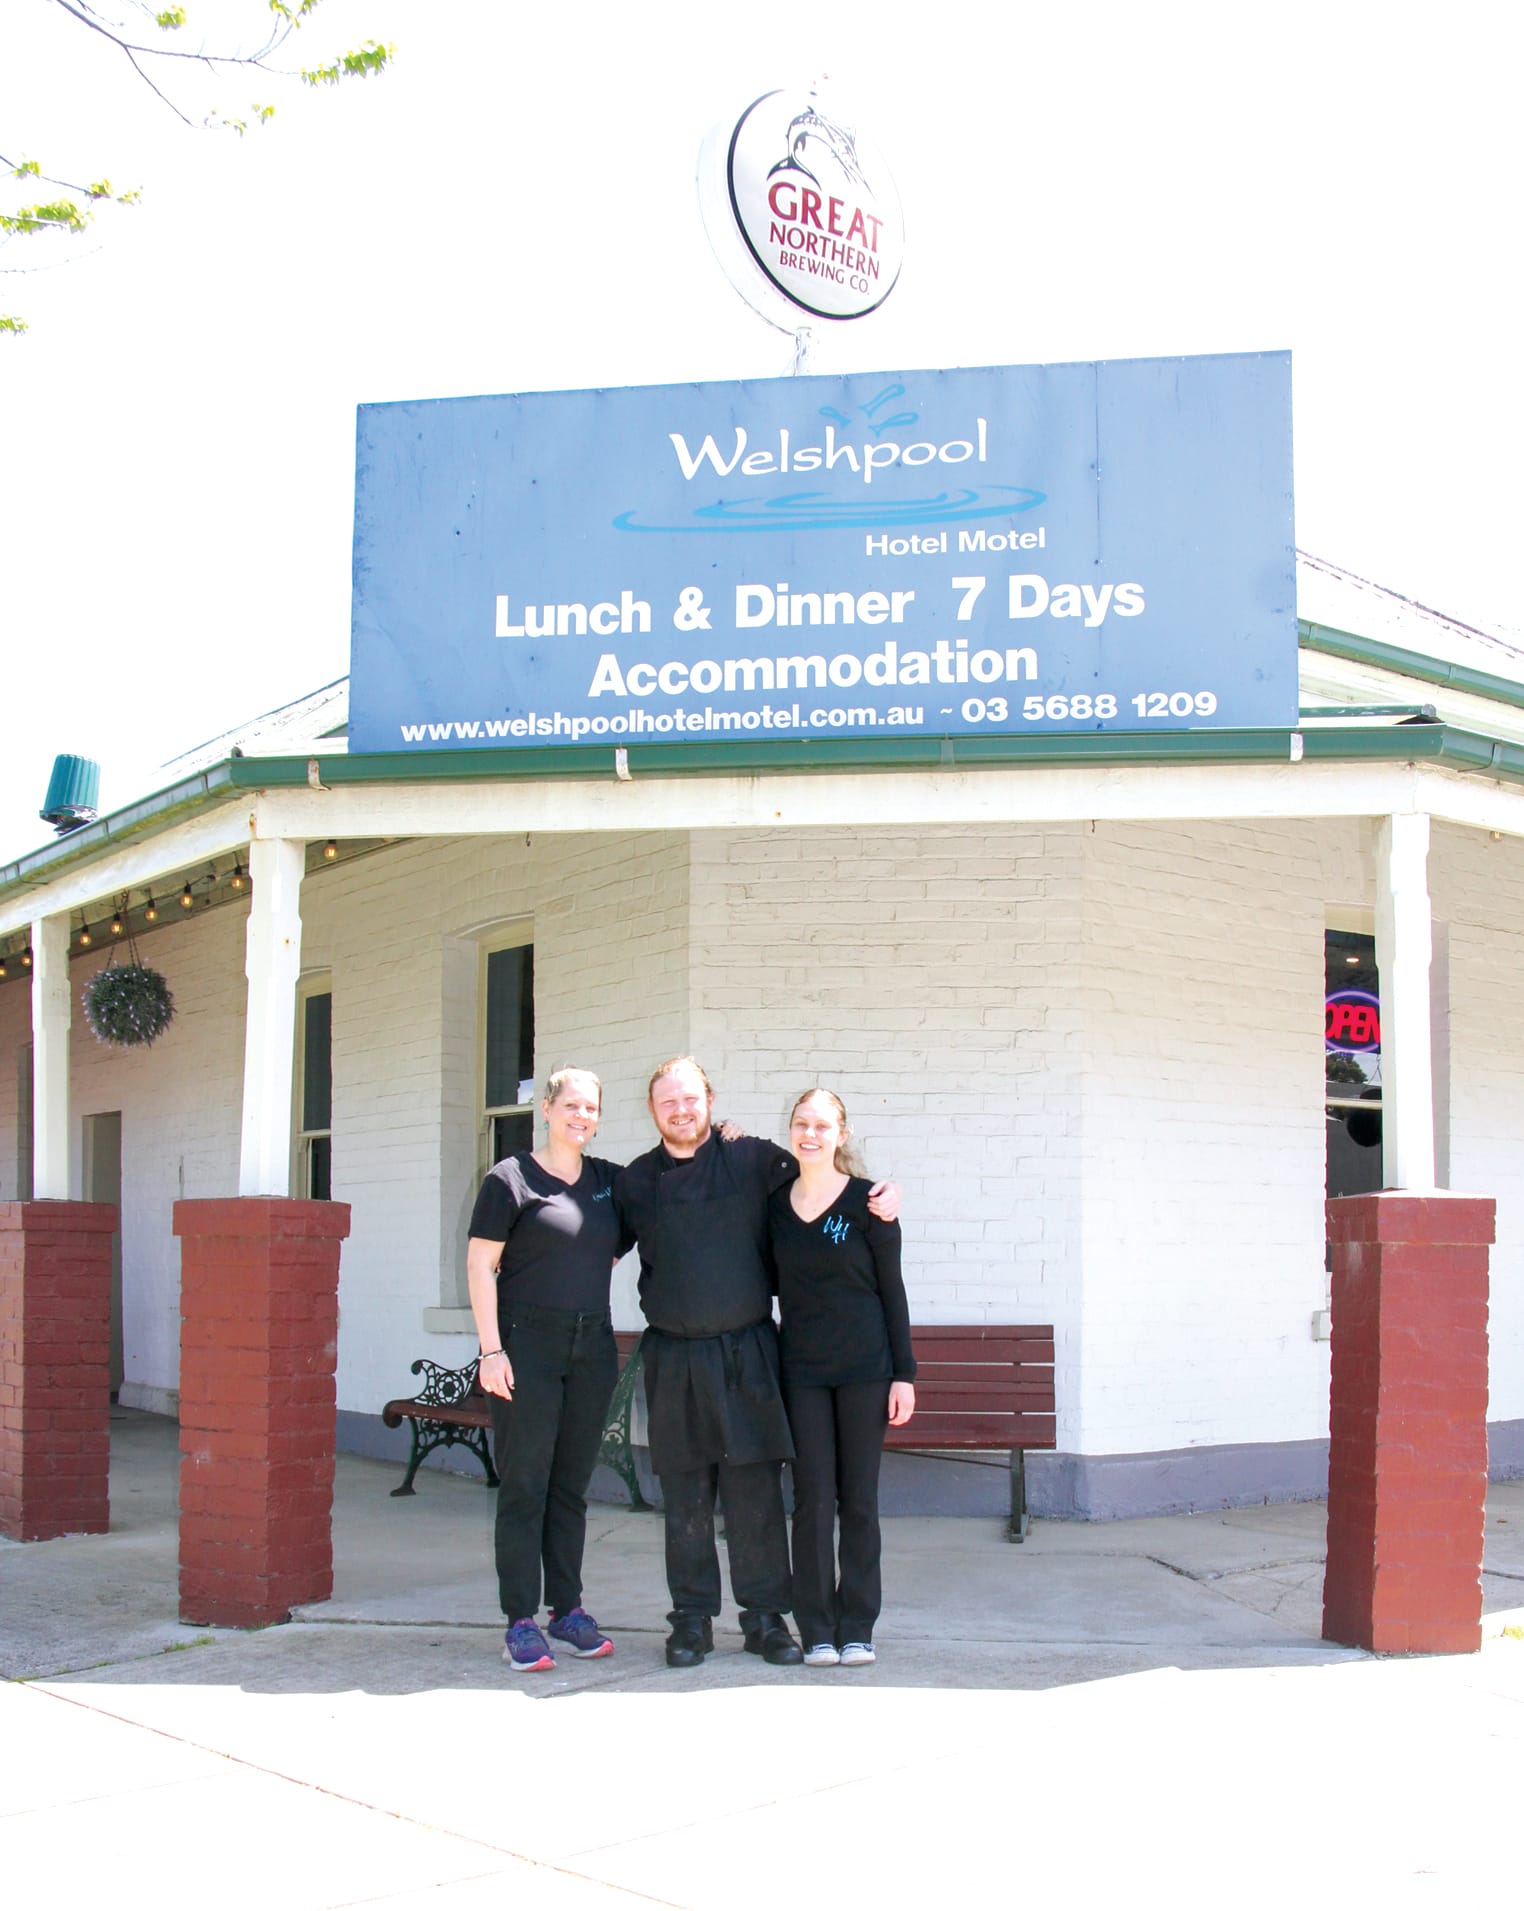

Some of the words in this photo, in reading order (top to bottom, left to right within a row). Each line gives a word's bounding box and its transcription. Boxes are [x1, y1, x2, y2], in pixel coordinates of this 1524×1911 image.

[767, 181, 883, 254] GREAT
[769, 221, 880, 281] NORTHERN
[779, 251, 845, 285] BREWING
[849, 274, 869, 296] CO.
[669, 417, 987, 484] Welshpool
[865, 532, 948, 556] Hotel
[958, 527, 1046, 553] Motel
[495, 590, 652, 638] Lunch
[673, 586, 713, 632] &
[735, 583, 915, 628] Dinner
[951, 576, 986, 621] 7
[1008, 574, 1146, 628] Days
[588, 639, 1039, 697] Accommodation
[400, 703, 924, 742] www.welshpoolhotelmotel.com.au
[961, 697, 1009, 723] 03
[1022, 694, 1118, 721] 5688
[1131, 691, 1218, 717] 1209
